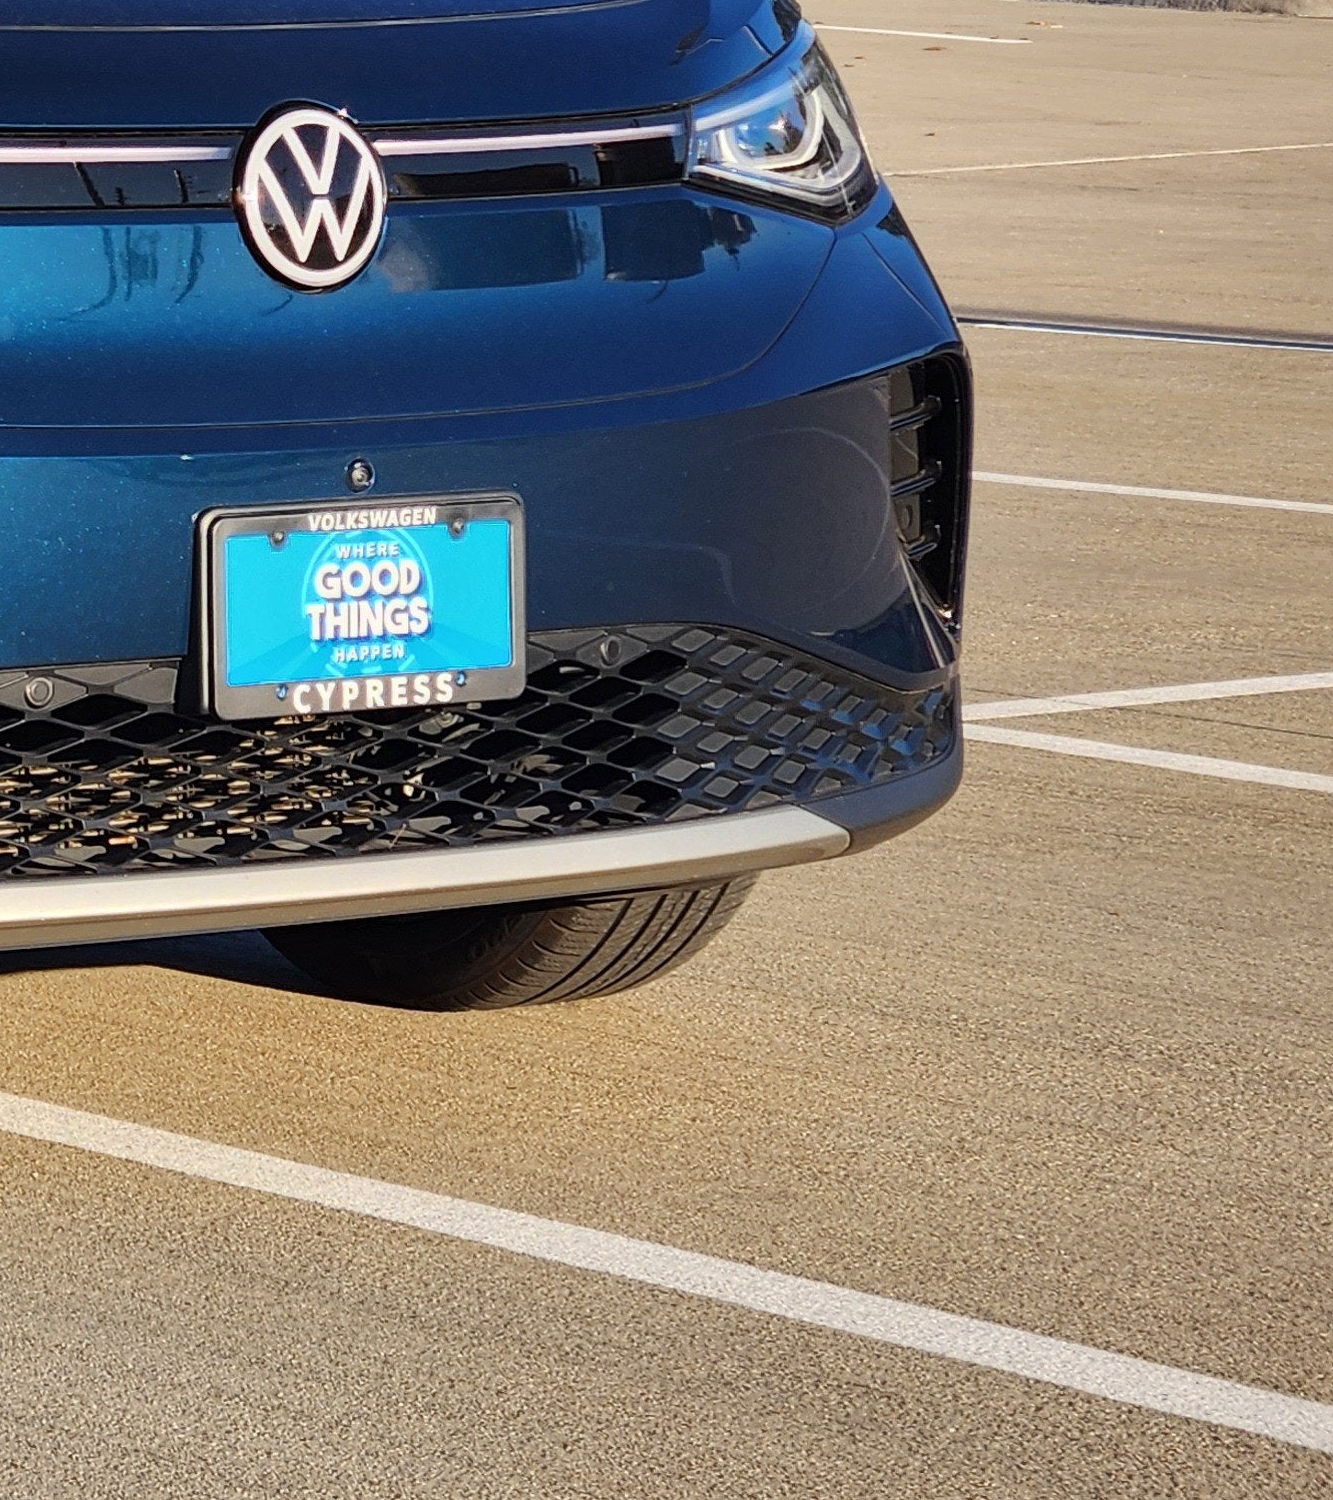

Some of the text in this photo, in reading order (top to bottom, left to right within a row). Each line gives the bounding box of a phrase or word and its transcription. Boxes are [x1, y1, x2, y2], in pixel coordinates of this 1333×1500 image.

[250, 116, 379, 276] VW
[307, 505, 438, 532] VOLKSWAGEN
[335, 541, 401, 560] WHERE
[314, 558, 422, 599] GOOD
[306, 596, 431, 640] THINGS
[335, 642, 406, 663] HAPPEN
[293, 672, 454, 714] CYPRESS
